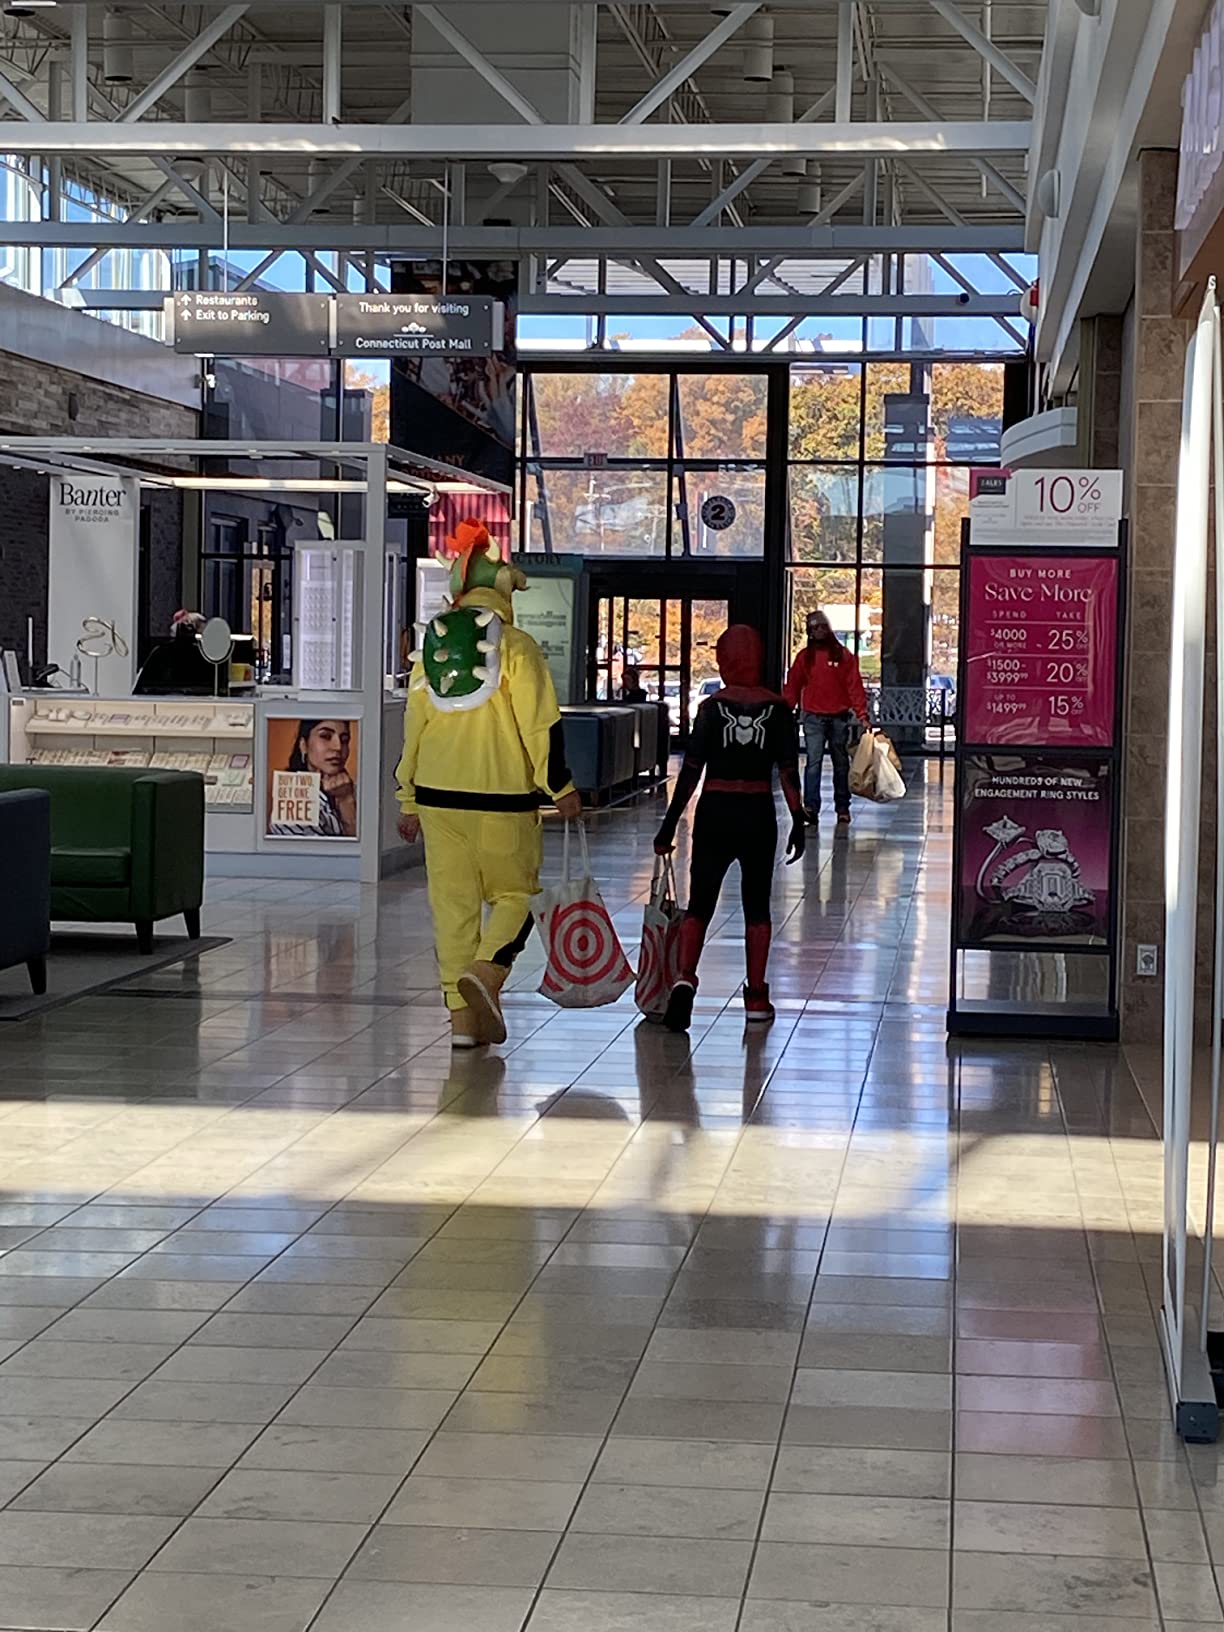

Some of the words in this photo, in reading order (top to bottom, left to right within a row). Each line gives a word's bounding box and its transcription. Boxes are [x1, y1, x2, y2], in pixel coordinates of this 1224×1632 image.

[196, 295, 258, 306] Restaurants
[359, 302, 390, 314] Thank
[392, 305, 411, 316] you
[413, 302, 429, 314] for
[431, 303, 470, 317] visiting
[196, 310, 215, 321] Exit
[217, 310, 229, 321] to
[231, 310, 270, 324] Parking
[355, 338, 419, 350] Connecticut
[422, 338, 446, 350] Post
[449, 338, 472, 350] Mall
[59, 482, 126, 507] Banter
[1034, 476, 1101, 513] 10%
[711, 504, 725, 520] 2
[1078, 503, 1101, 513] OFF
[1009, 569, 1032, 579] BUY
[1038, 569, 1072, 579] MORE
[985, 582, 1033, 602] Save
[1040, 583, 1093, 603] More
[992, 610, 1027, 619] SPEND
[1056, 611, 1082, 620] TAKE
[990, 628, 1027, 641] $4000
[1048, 630, 1089, 650] 25%
[1046, 663, 1088, 683] 20%
[1049, 696, 1084, 715] 15%
[992, 776, 1044, 786] HUNDREDS
[1045, 777, 1057, 786] OF
[1060, 778, 1083, 787] NEW
[278, 787, 292, 798] GET
[294, 788, 309, 799] ONE
[975, 789, 1038, 799] ENGAGEMENT
[1040, 790, 1064, 799] RING
[1066, 791, 1100, 800] STYLES
[278, 800, 312, 821] FREE
